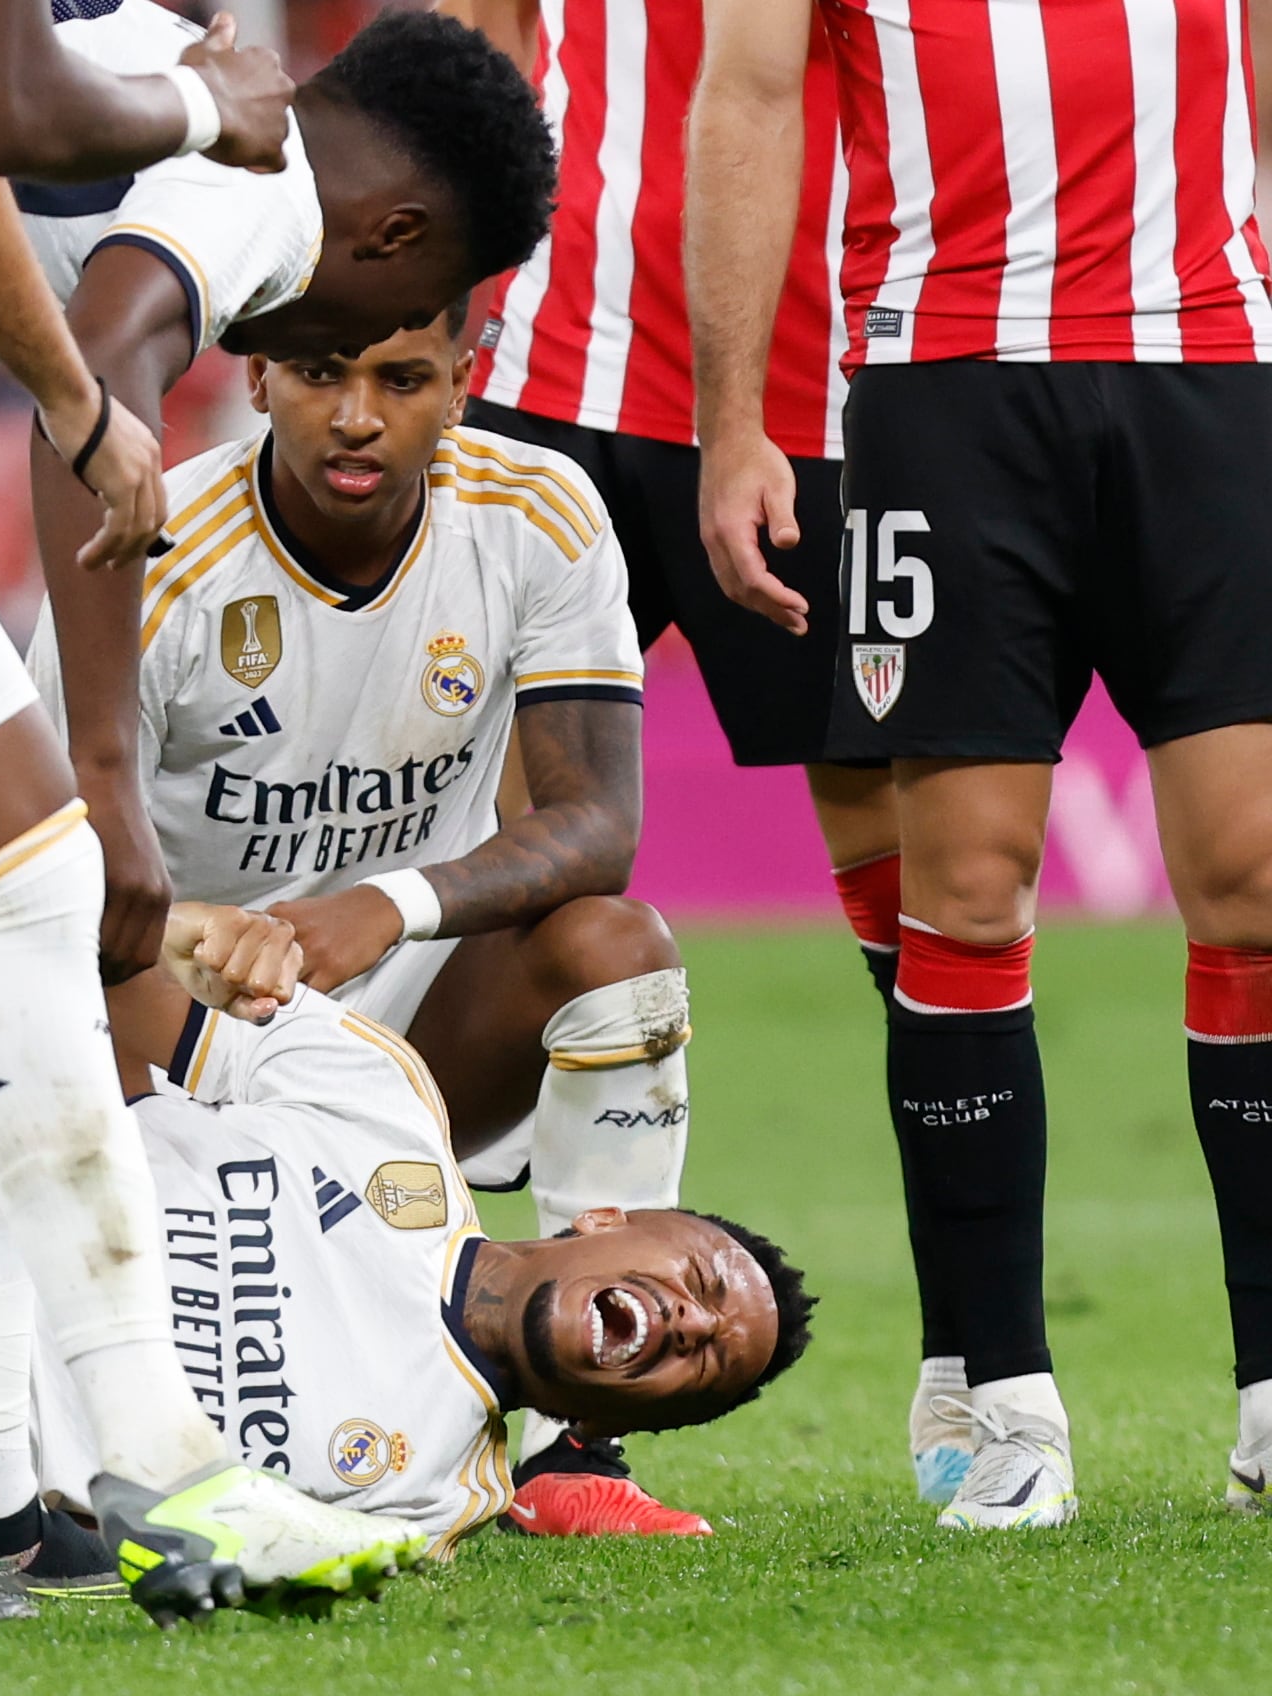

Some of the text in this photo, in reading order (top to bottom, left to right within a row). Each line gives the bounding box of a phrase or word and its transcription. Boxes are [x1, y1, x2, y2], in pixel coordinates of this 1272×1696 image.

[845, 508, 935, 639] 15
[238, 653, 267, 667] FIFA
[205, 737, 476, 825] Emirates
[239, 803, 438, 873] FLY BETTER
[903, 1090, 1014, 1112] ATHLETIC
[922, 1107, 990, 1126] CLUB
[382, 1180, 397, 1211] FIFA
[164, 1208, 219, 1271] FLY
